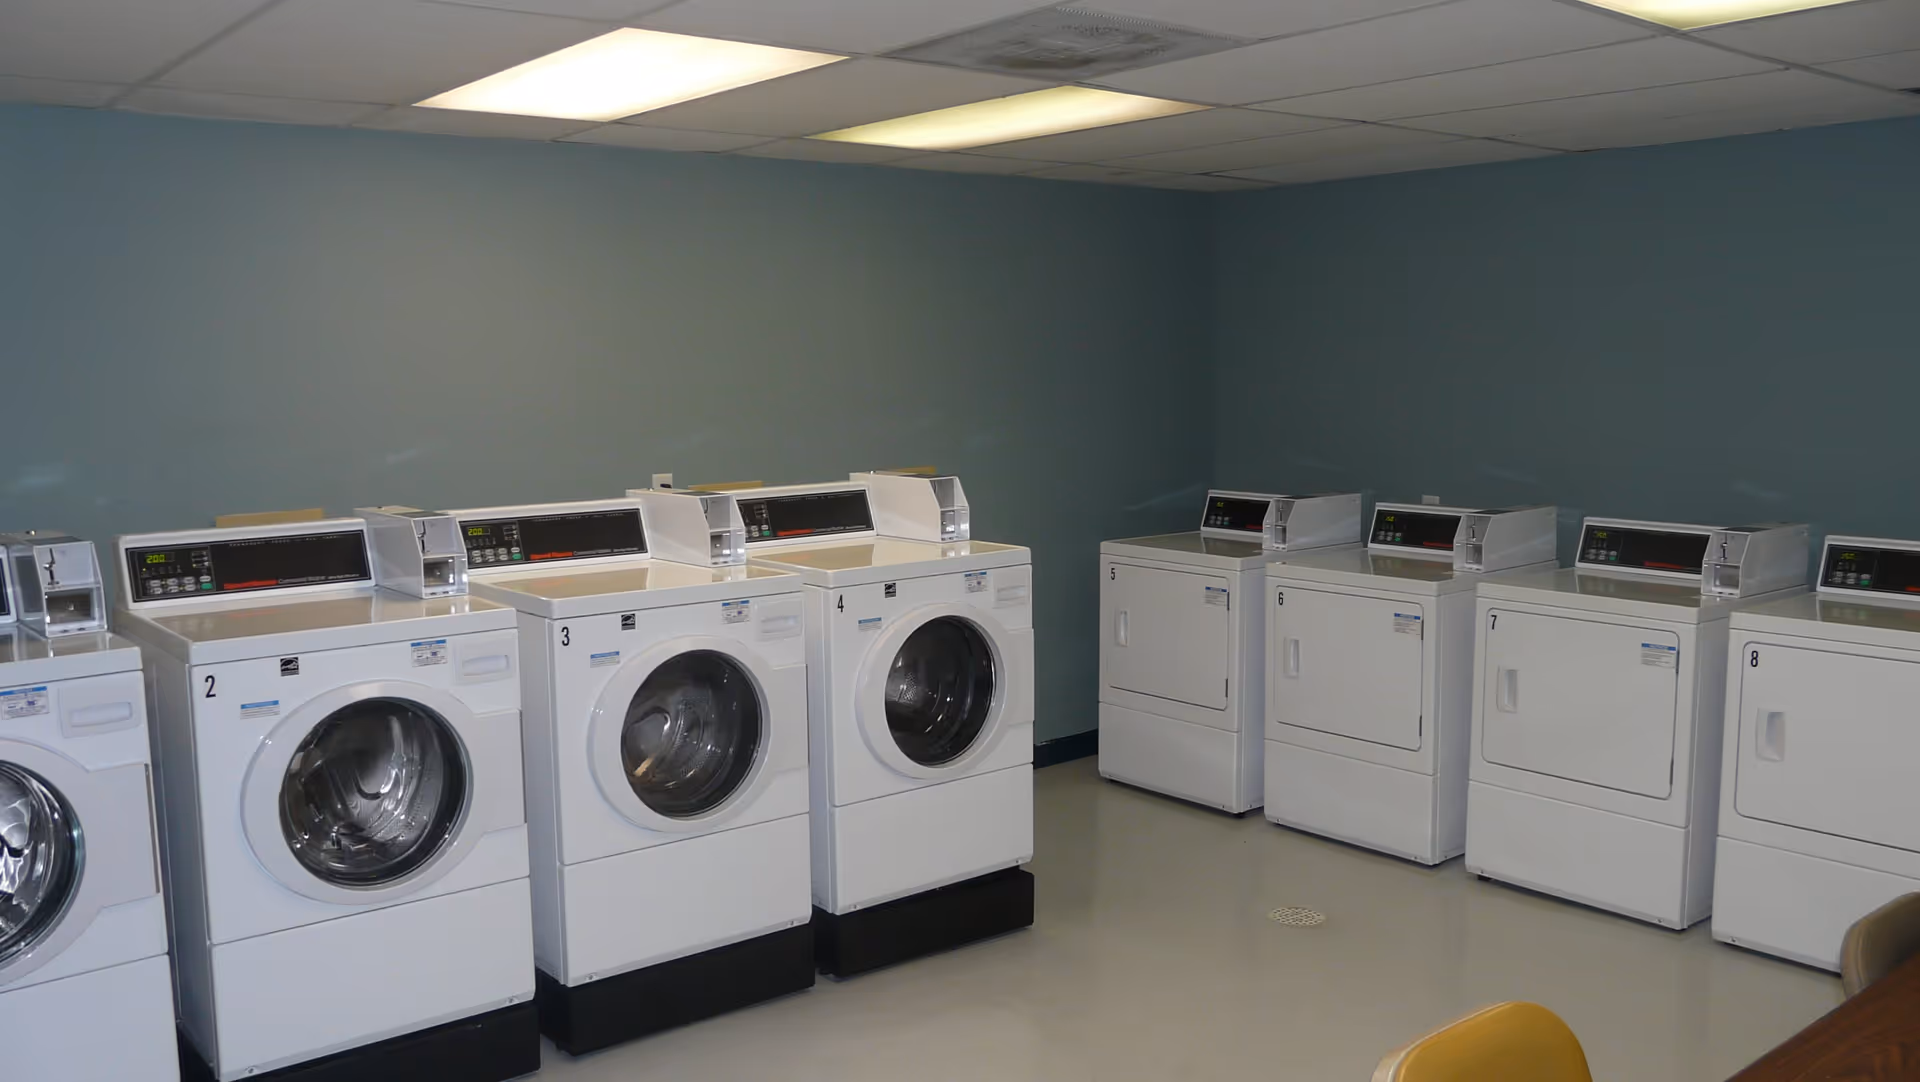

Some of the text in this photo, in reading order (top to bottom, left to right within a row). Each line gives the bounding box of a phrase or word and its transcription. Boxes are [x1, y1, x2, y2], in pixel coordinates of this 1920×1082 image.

[1110, 567, 1116, 581] 5
[837, 594, 844, 613] 4
[1278, 591, 1284, 606] 6
[1490, 614, 1497, 630] 7
[561, 626, 570, 647] 3
[1750, 650, 1759, 667] 8
[204, 675, 216, 698] 2
